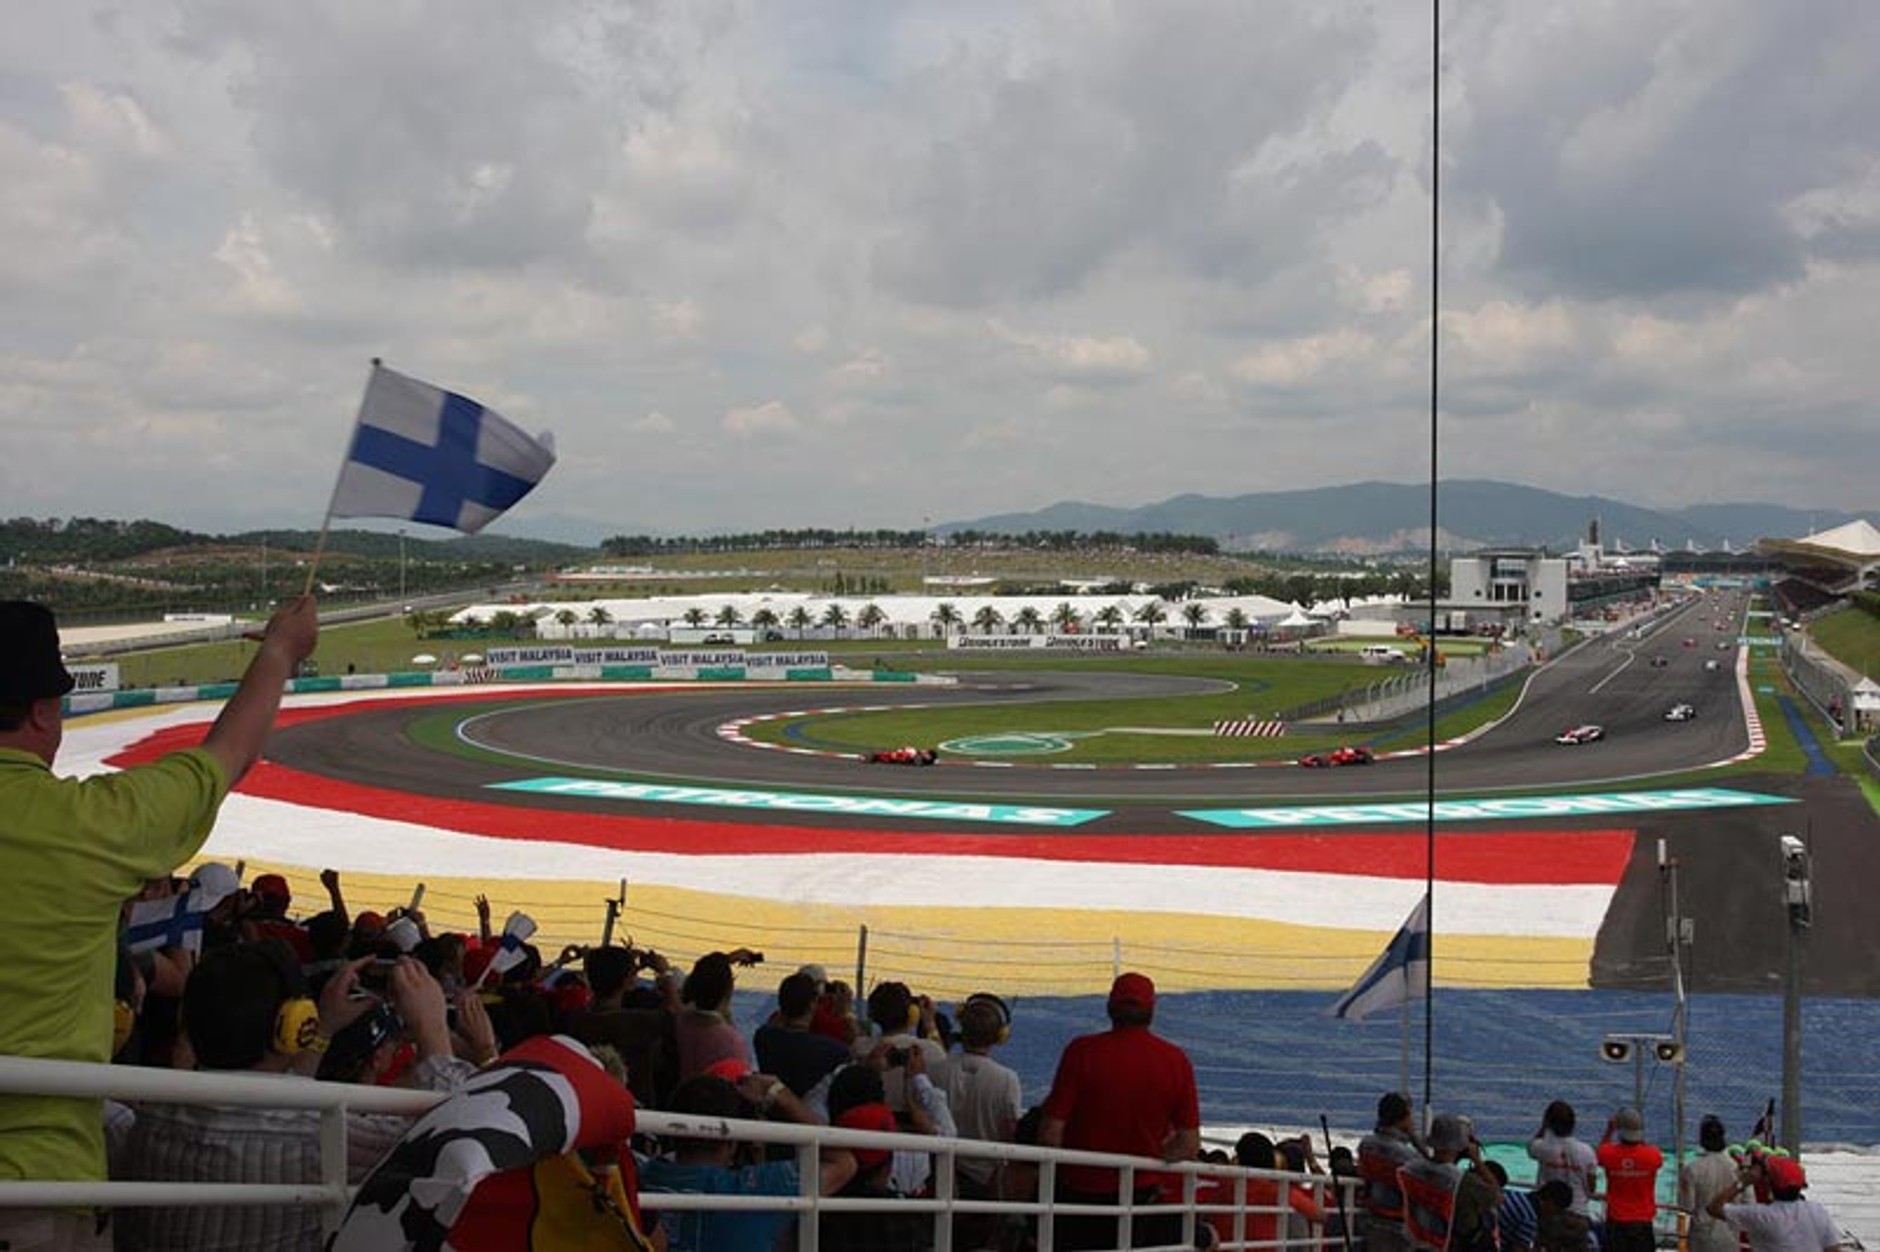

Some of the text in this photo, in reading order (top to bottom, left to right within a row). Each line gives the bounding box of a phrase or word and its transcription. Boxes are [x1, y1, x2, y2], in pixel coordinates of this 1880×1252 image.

[489, 648, 572, 664] VISIT MALAYSIA
[575, 648, 657, 663] VISIT MALAYSIA
[660, 652, 744, 665] VISIT MALAYSIA
[745, 653, 825, 666] VISIT MALAYSIA
[541, 780, 1076, 822] PETRONAS
[1244, 789, 1753, 823] PETRONAS
